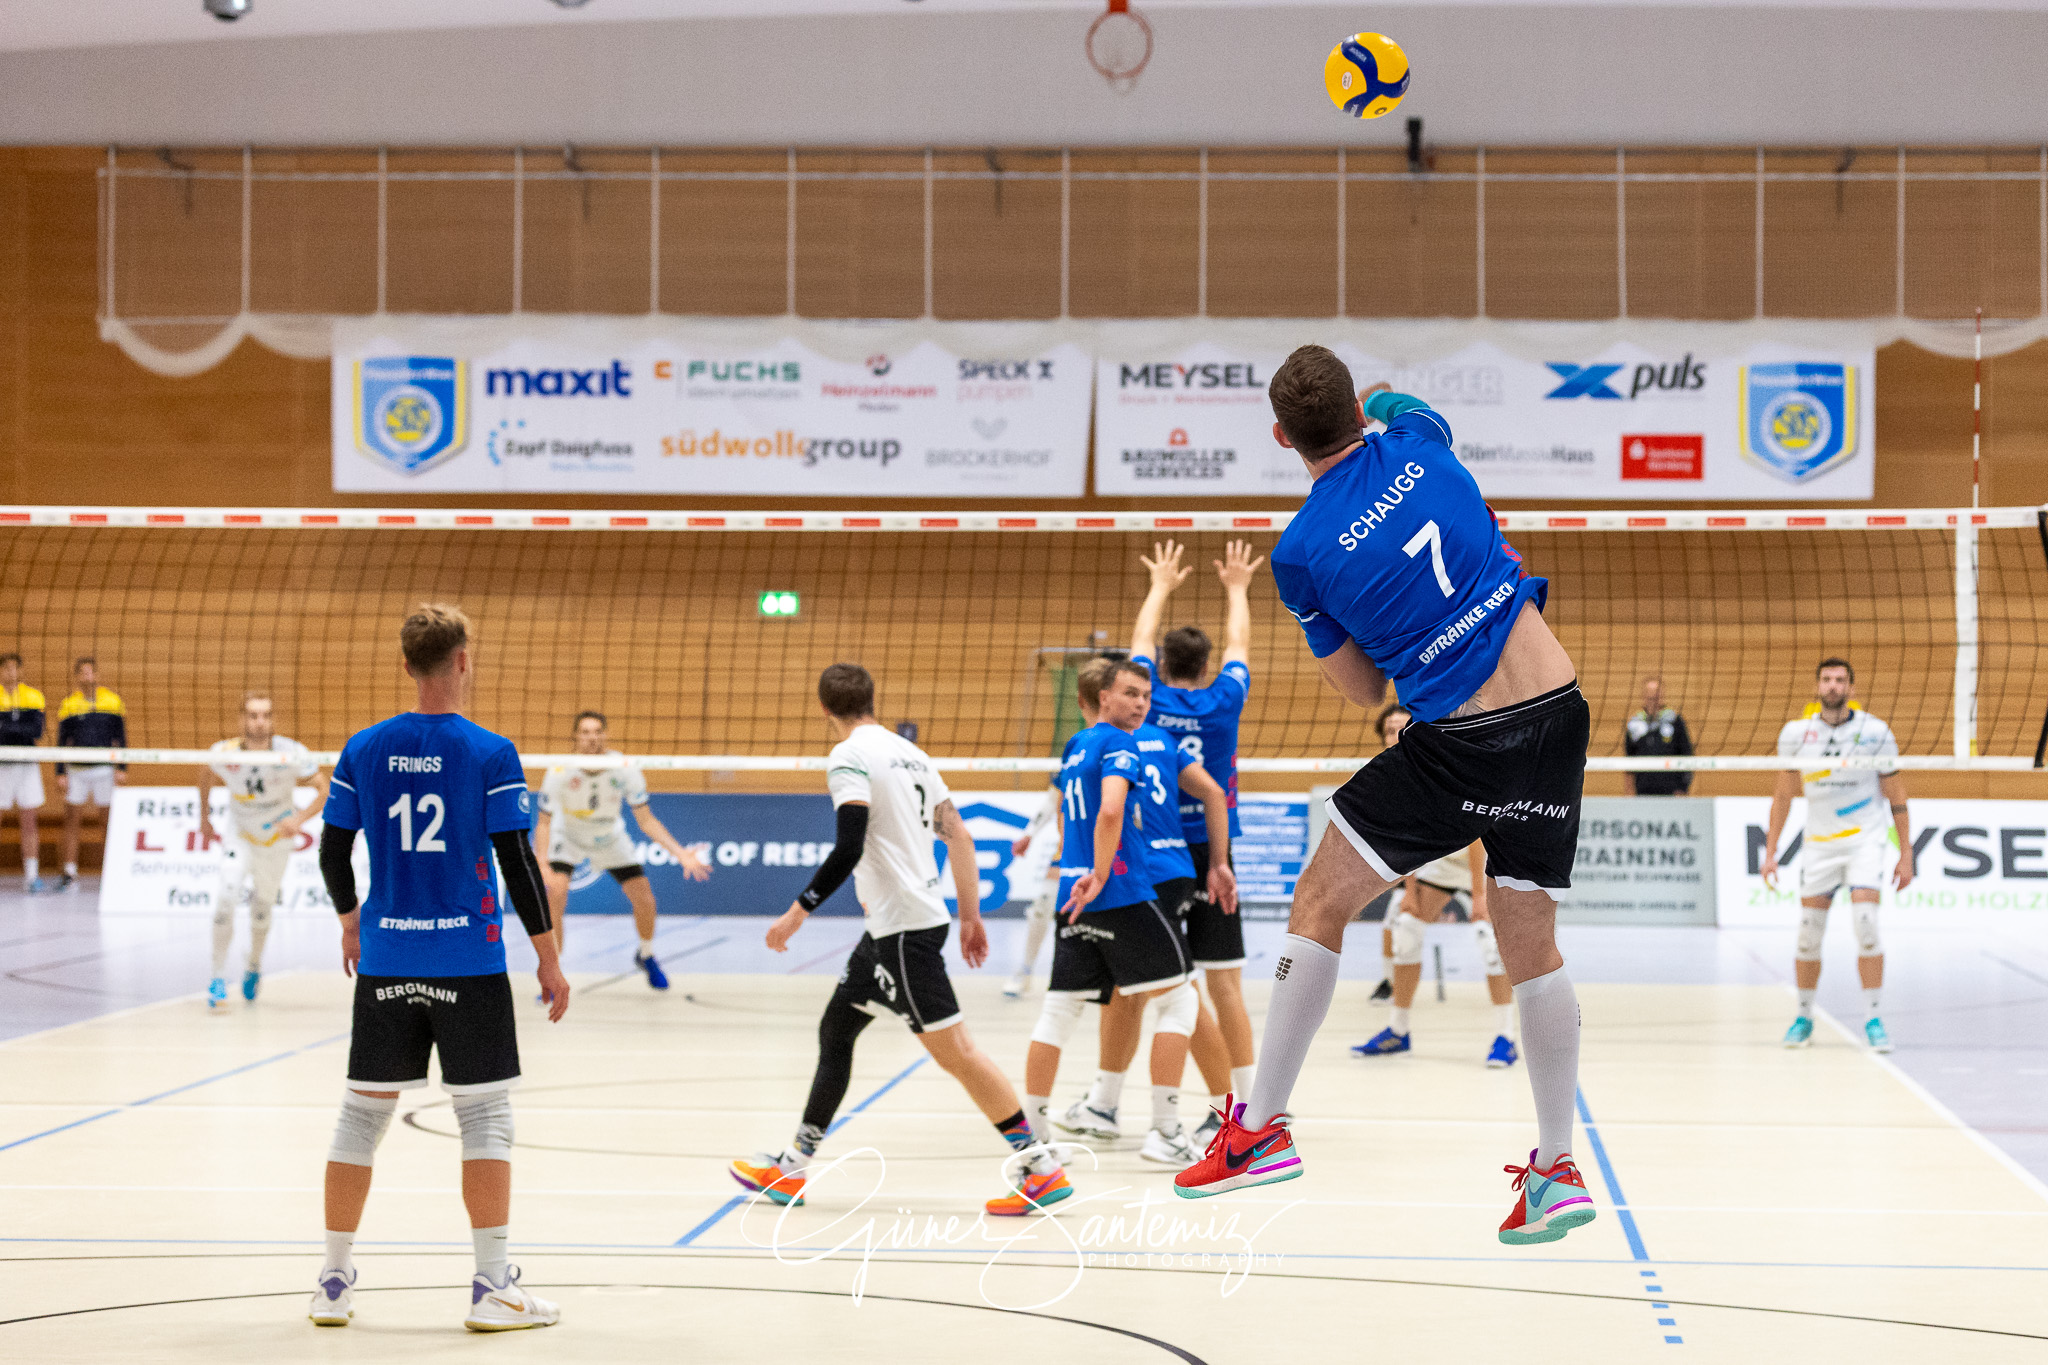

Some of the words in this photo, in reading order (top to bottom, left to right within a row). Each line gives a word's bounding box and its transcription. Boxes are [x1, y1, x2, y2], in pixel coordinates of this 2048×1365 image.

[486, 359, 632, 398] maxit
[687, 360, 802, 382] FUCHS
[1119, 363, 1265, 389] MEYSEL
[1630, 354, 1707, 400] puls
[1338, 461, 1425, 552] SCHAUGG
[1401, 519, 1456, 599] 7
[388, 755, 443, 773] FRINGS
[1144, 764, 1167, 806] 3
[1064, 777, 1087, 821] 11
[388, 793, 447, 852] 12
[1578, 819, 1698, 840] ERSONAL
[716, 841, 759, 867] OF
[1576, 848, 1695, 867] RAINING
[168, 888, 210, 906] fon
[1895, 890, 1957, 910] UND
[437, 915, 469, 930] RECK
[375, 982, 458, 1005] BERGMANN
